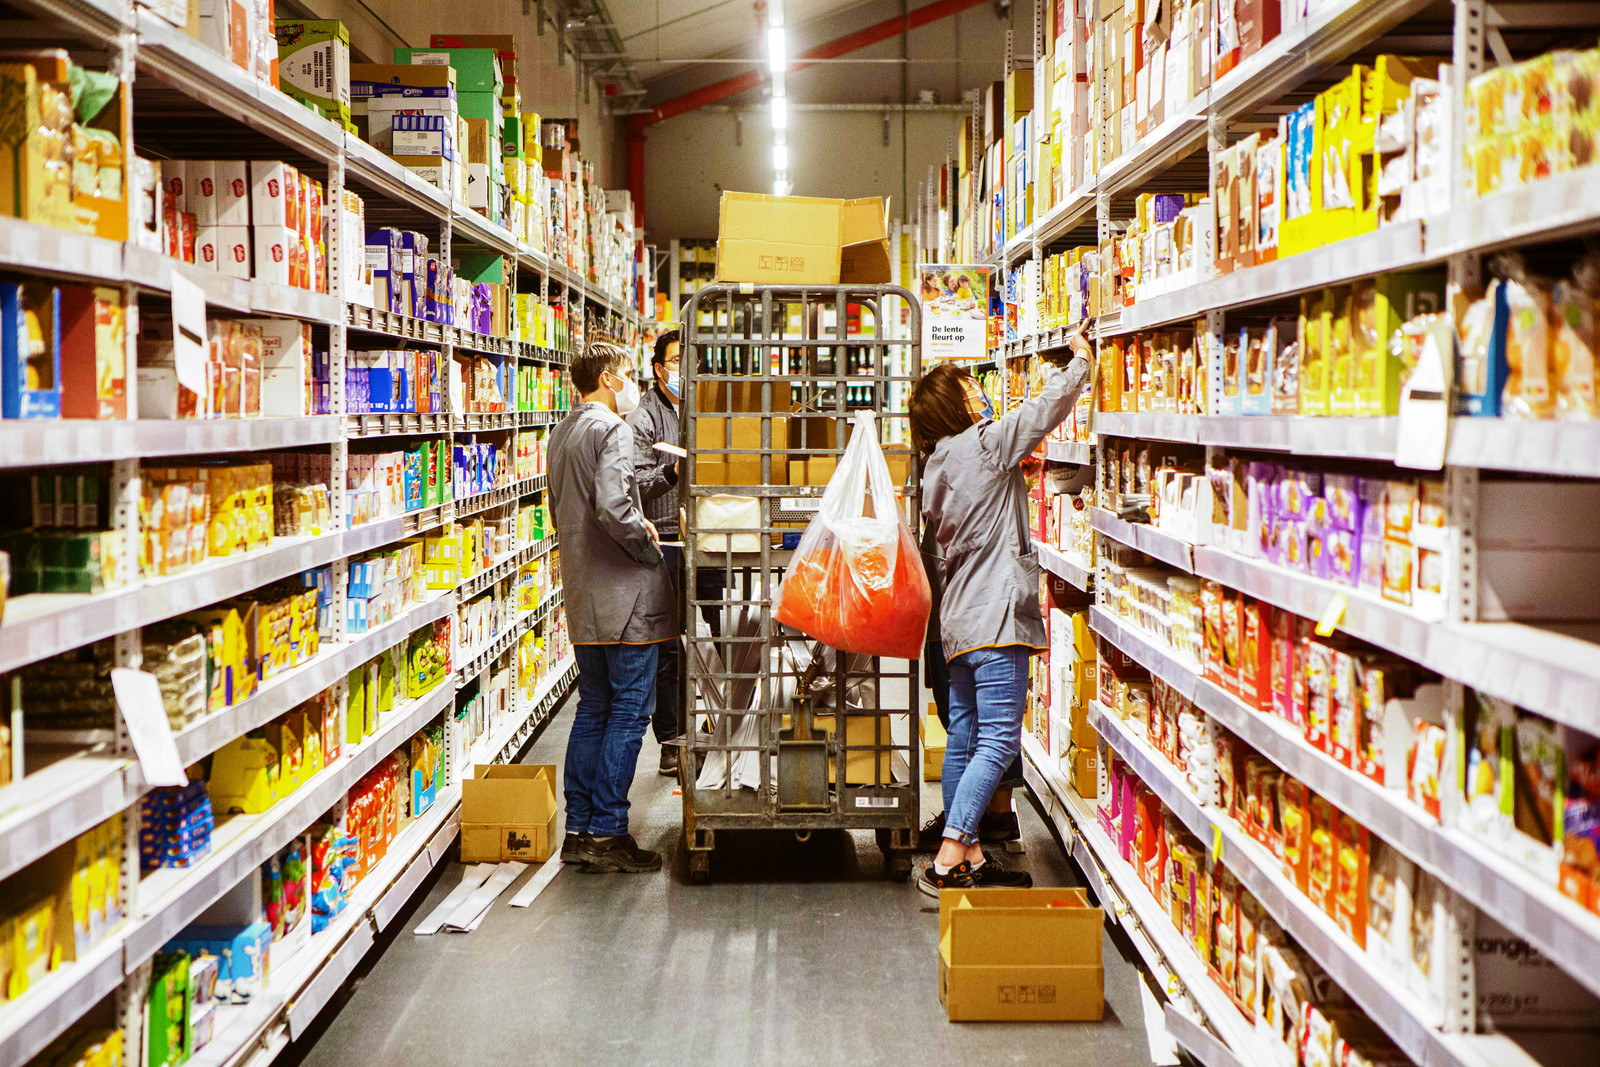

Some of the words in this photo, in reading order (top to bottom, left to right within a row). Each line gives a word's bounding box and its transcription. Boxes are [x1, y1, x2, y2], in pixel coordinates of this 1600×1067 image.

[415, 168, 438, 176] Everyday
[932, 325, 942, 333] De
[944, 325, 963, 333] lente
[932, 333, 952, 341] fleurt
